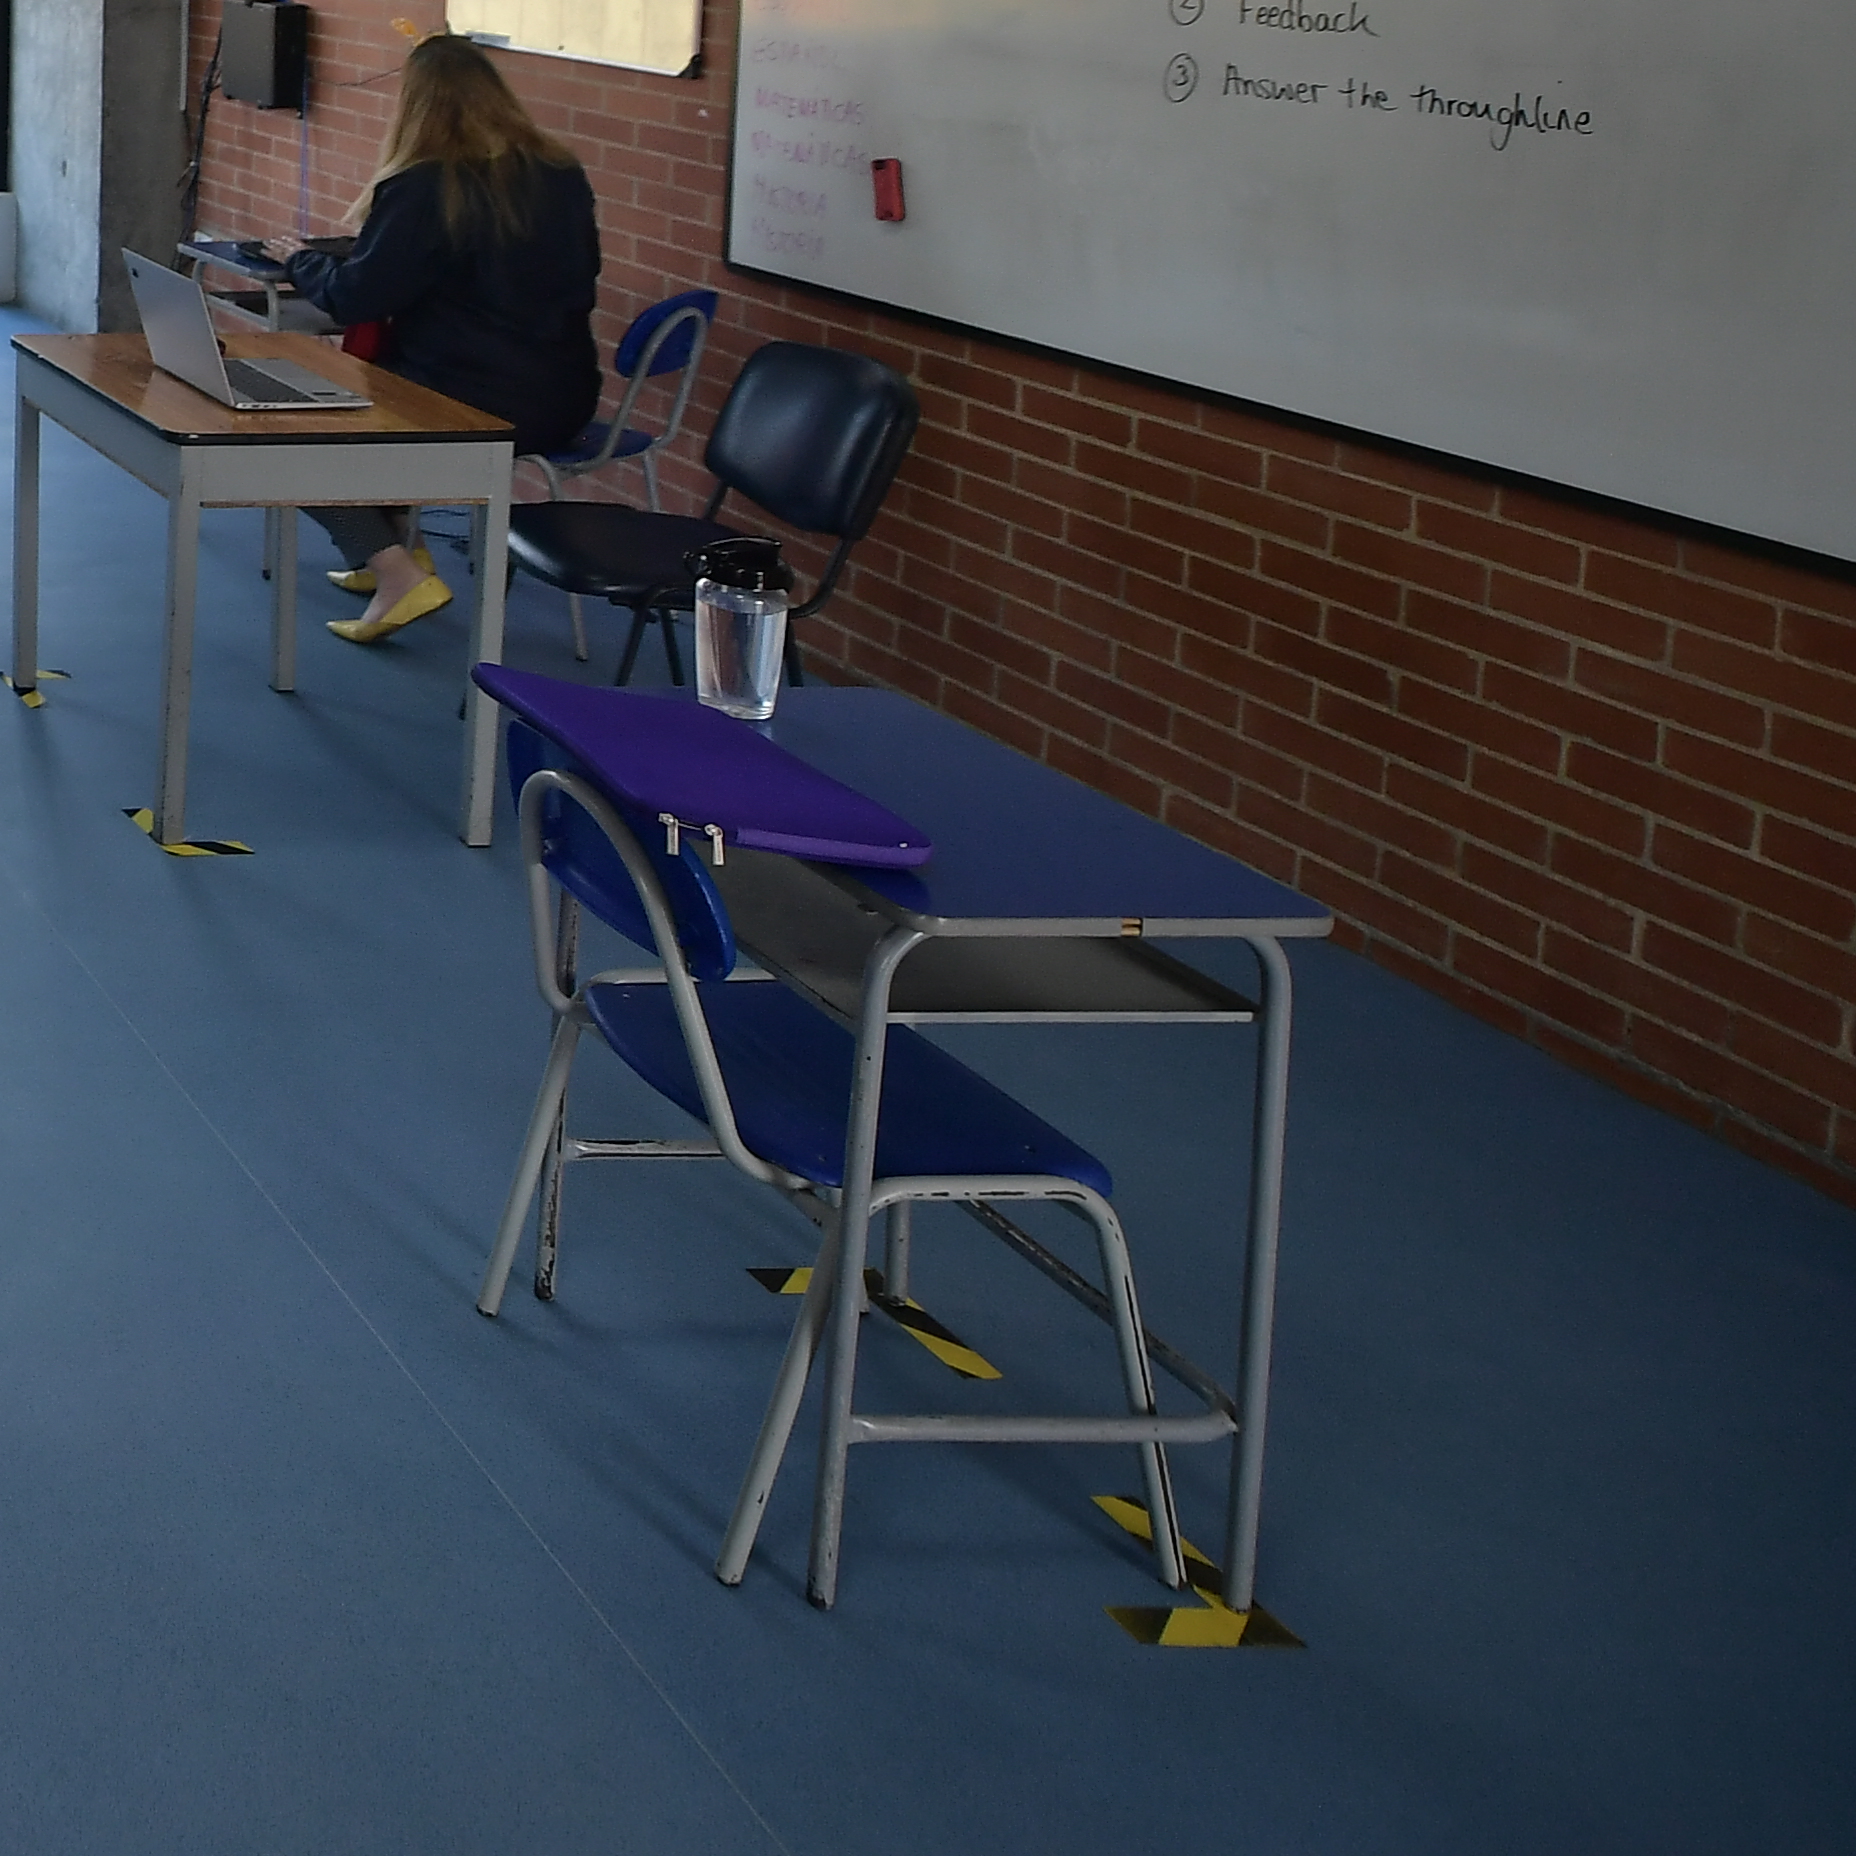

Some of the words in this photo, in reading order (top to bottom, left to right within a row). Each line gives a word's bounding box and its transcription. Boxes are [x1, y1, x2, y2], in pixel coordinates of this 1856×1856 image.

[1222, 62, 1329, 105] Answer
[1337, 76, 1399, 112] the
[1410, 80, 1595, 152] throughline
